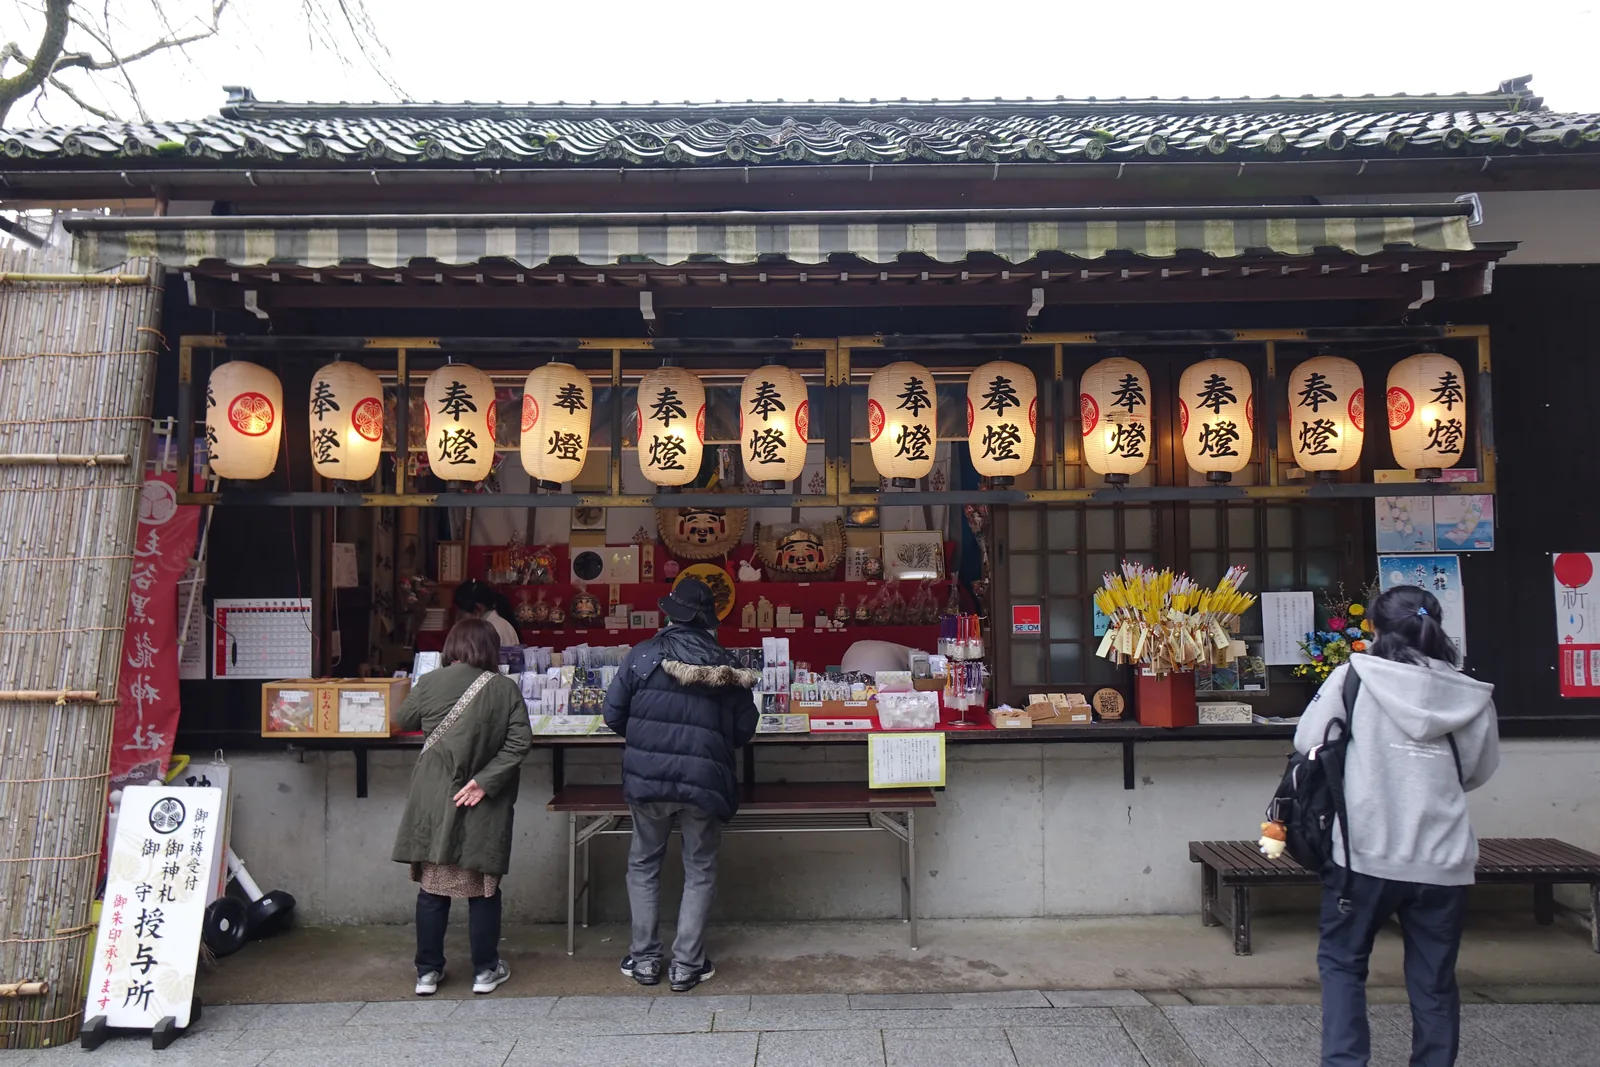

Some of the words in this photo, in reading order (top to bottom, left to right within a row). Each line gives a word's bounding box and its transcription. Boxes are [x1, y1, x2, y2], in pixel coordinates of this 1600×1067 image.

[310, 380, 340, 465] 奉燈
[438, 380, 479, 466] 奉燈
[547, 382, 589, 462] 奉燈
[648, 386, 688, 471] 奉燈
[748, 380, 788, 465] 奉燈
[893, 376, 932, 461] 奉燈
[979, 375, 1021, 461] 奉燈
[1109, 372, 1147, 458] 奉燈
[1195, 373, 1240, 458] 奉燈
[1296, 371, 1339, 456] 奉燈
[1423, 370, 1463, 455] 奉燈
[1562, 587, 1589, 635] 祈り
[322, 690, 331, 731] おみくじ
[157, 838, 184, 903] 御神札
[97, 893, 128, 1011] 御朱印承ります
[122, 907, 166, 1012] 授与所
